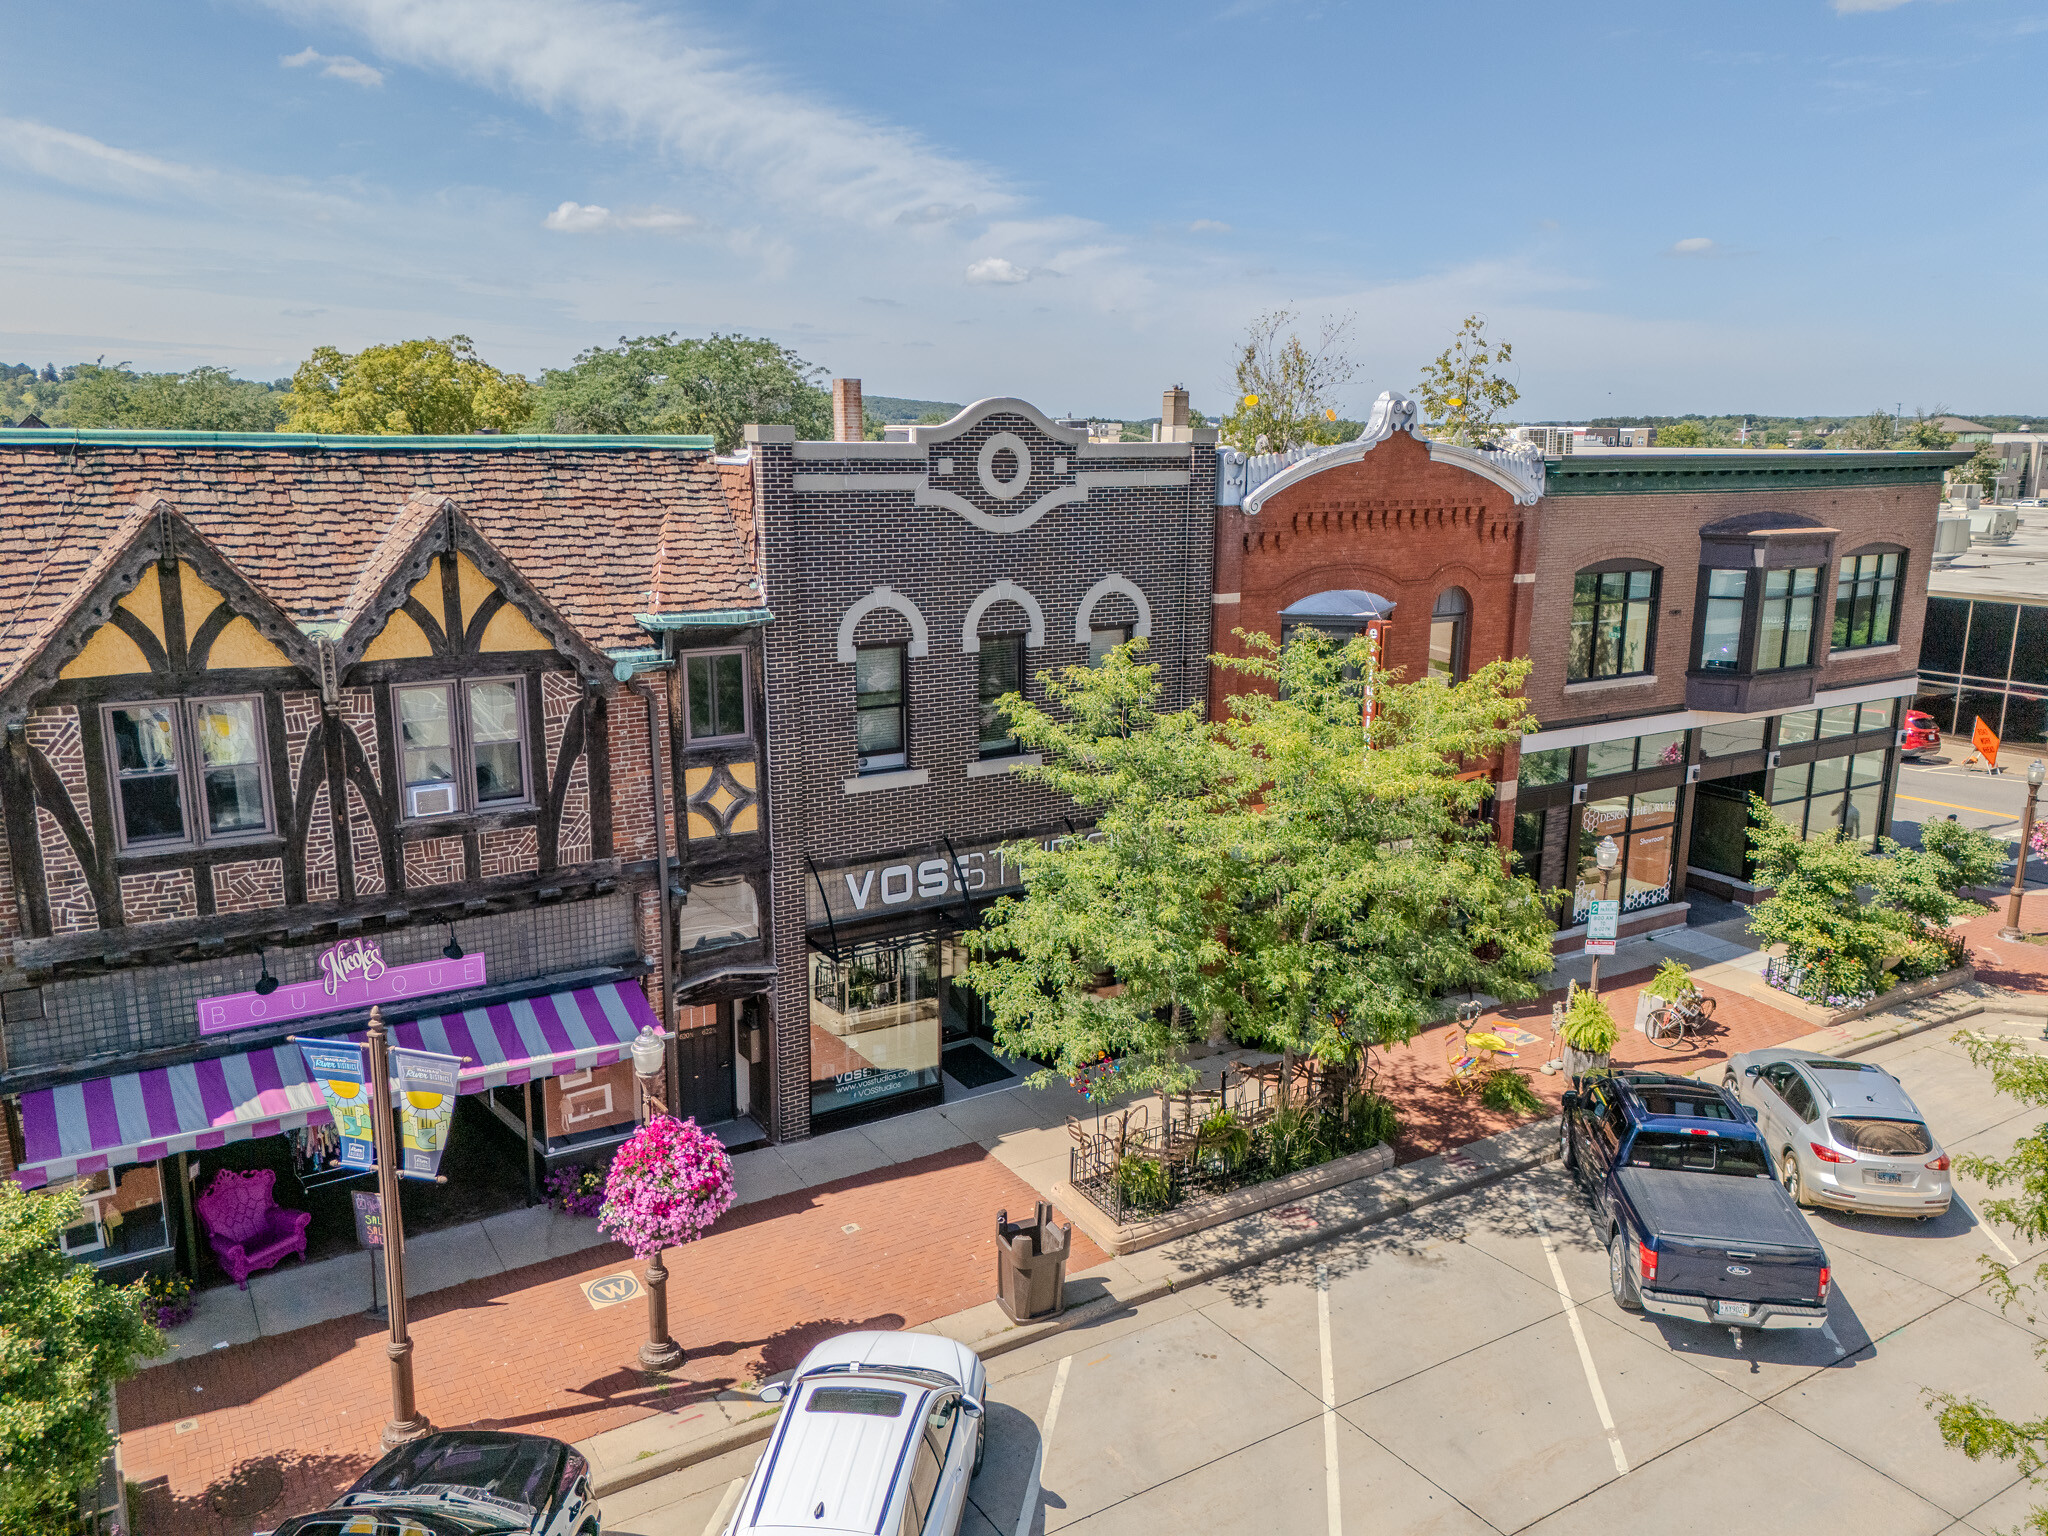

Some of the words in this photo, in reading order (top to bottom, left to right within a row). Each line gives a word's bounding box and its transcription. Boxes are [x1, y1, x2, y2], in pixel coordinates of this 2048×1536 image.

[1600, 808, 1630, 823] DESIGN
[1640, 835, 1664, 846] Showroom
[1591, 903, 1598, 914] 2
[321, 940, 385, 995] Nicole's
[211, 962, 475, 1025] BOUTIQUE
[315, 1059, 336, 1069] River
[406, 1069, 429, 1080] River
[858, 1081, 902, 1098] VOSStudios
[365, 1214, 382, 1225] SAL
[367, 1225, 384, 1236] SAL
[369, 1234, 384, 1245] SAL
[594, 1279, 626, 1300] W
